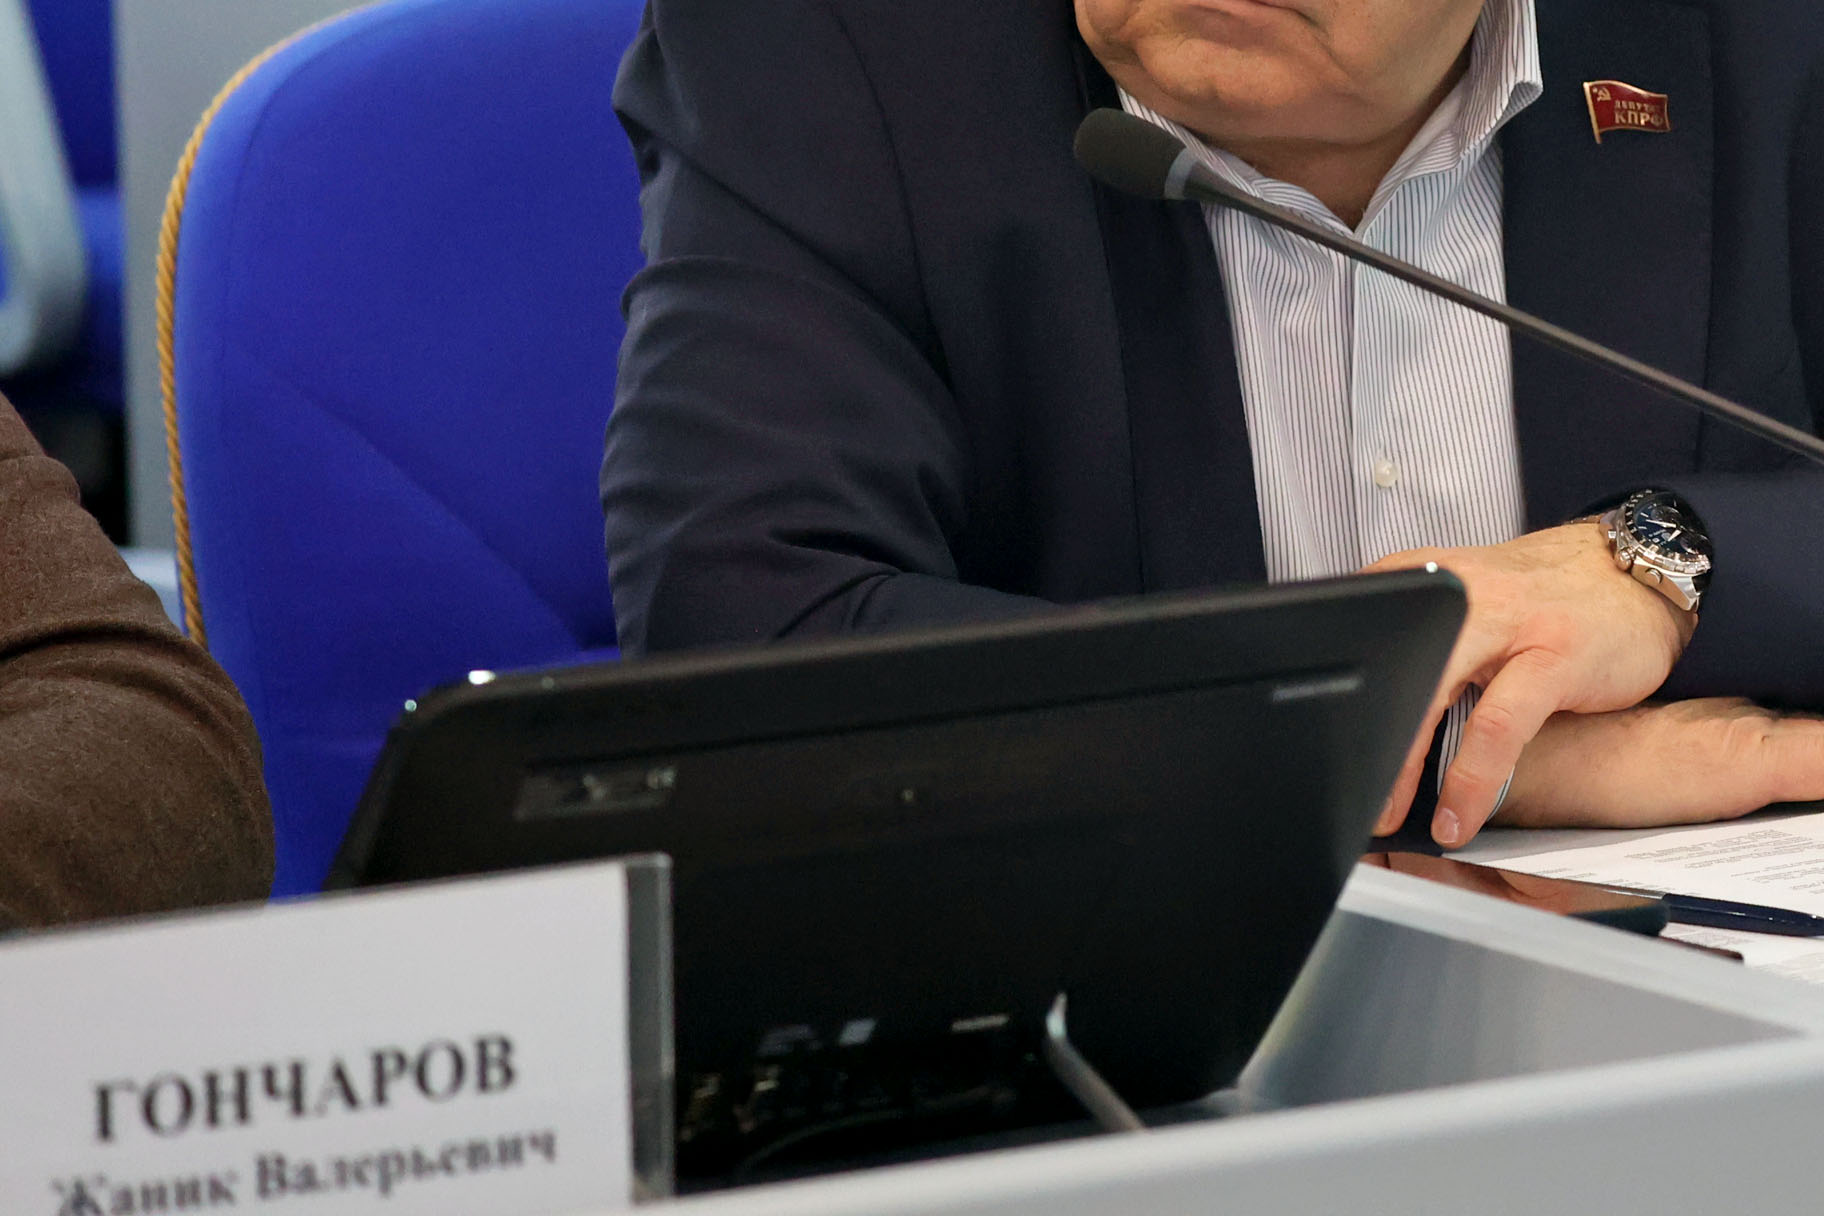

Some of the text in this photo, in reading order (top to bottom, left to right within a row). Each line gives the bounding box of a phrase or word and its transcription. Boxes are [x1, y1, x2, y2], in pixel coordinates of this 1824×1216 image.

[1615, 100, 1660, 113] ДЕПУТ
[1615, 111, 1663, 126] КПРФ
[94, 1034, 517, 1145] ГОНЧАРОВ
[255, 1130, 557, 1201] Валерьевич
